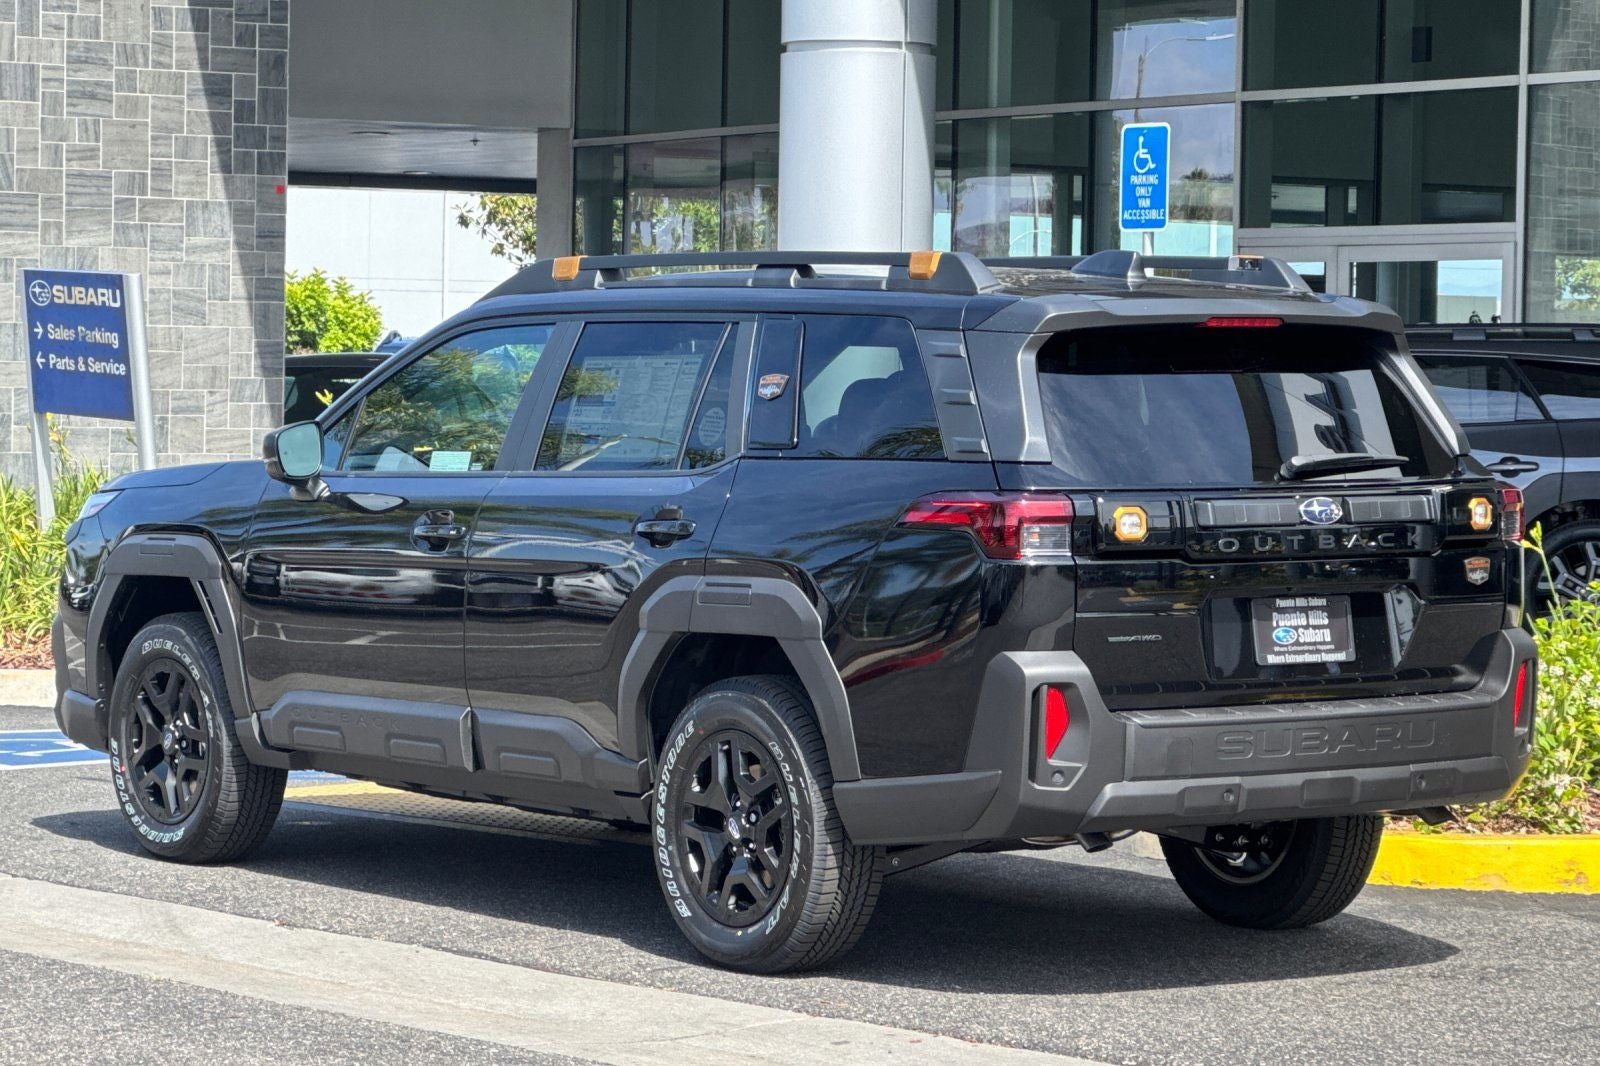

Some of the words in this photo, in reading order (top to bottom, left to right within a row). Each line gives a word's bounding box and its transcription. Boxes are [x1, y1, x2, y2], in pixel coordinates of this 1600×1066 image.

[1130, 174, 1158, 184] PARKING
[1135, 186, 1152, 196] ONLY
[1138, 197, 1150, 207] VAN
[1123, 209, 1165, 220] ACCESSIBLE
[52, 285, 121, 308] SUBARU
[47, 323, 76, 341] Sales
[77, 326, 119, 349] Parking
[49, 354, 75, 371] Parts
[77, 356, 86, 371] &
[87, 357, 126, 375] Service
[1218, 532, 1419, 553] OUTBACK
[1272, 611, 1307, 627] Puente
[1308, 610, 1329, 625] Hills
[1298, 627, 1331, 642] Subaru
[1215, 719, 1437, 760] SUBARU
[655, 720, 695, 918] BRIDGESTONE
